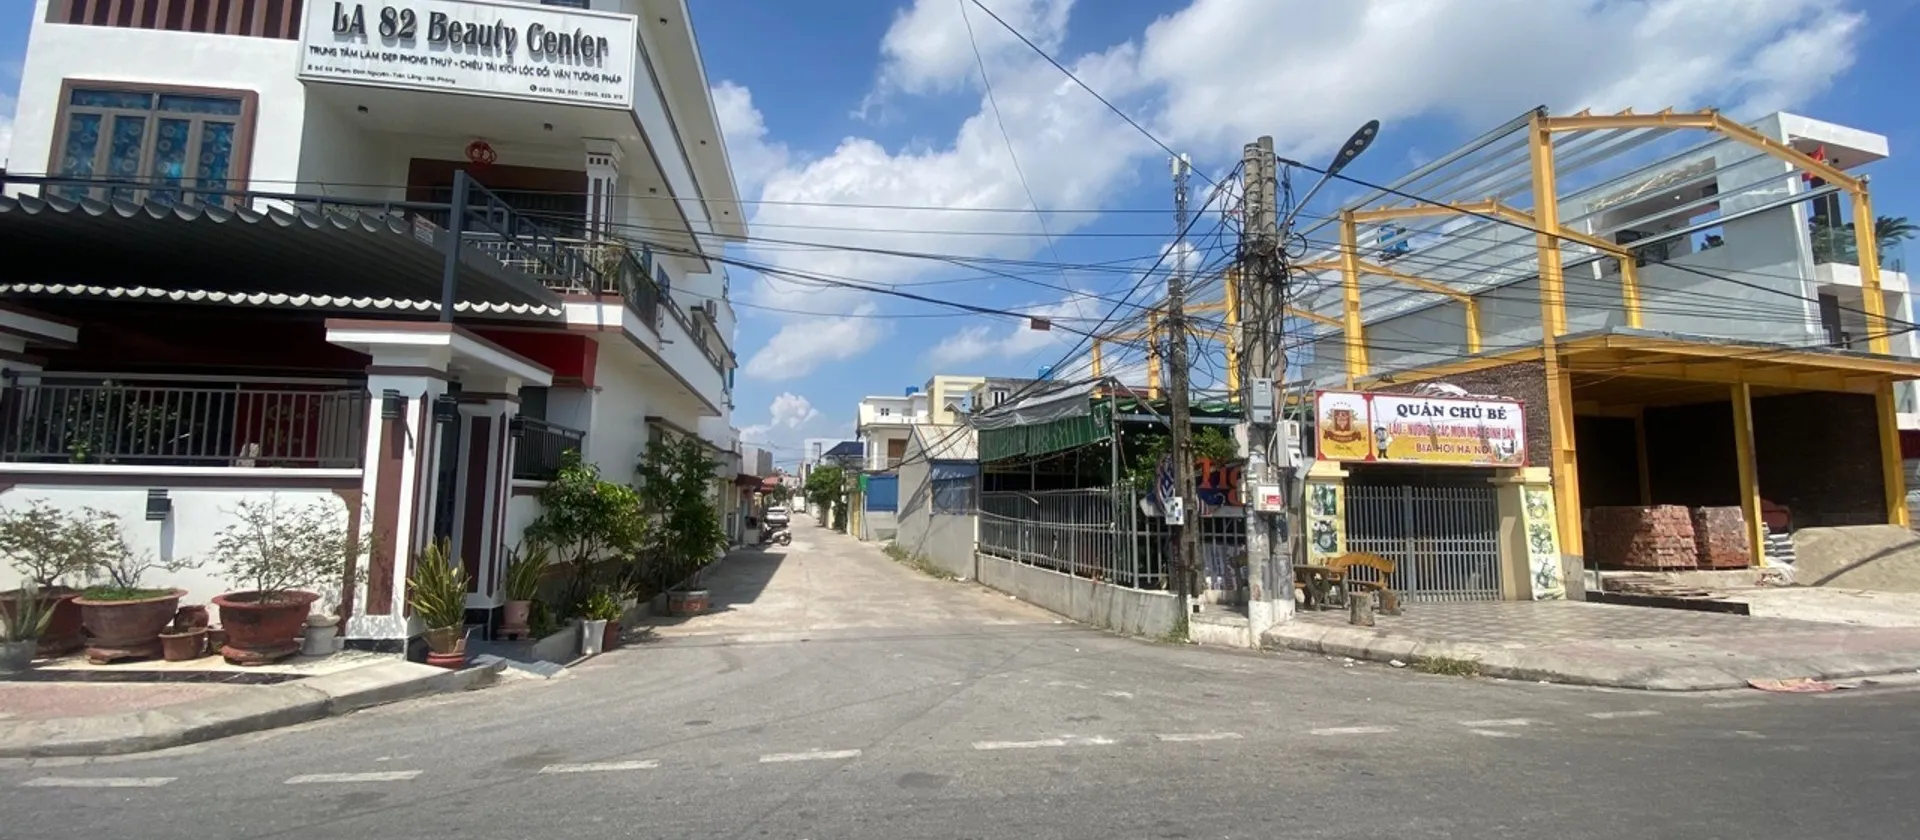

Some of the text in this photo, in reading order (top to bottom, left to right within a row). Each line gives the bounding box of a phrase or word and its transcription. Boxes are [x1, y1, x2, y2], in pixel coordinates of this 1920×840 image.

[332, 1, 608, 58] LA 82 Beauty Center
[309, 45, 338, 58] TRUNG
[340, 48, 359, 58] TÂM
[400, 55, 429, 66] PHONG
[1396, 402, 1508, 420] QUÁN CHÚ BÉ
